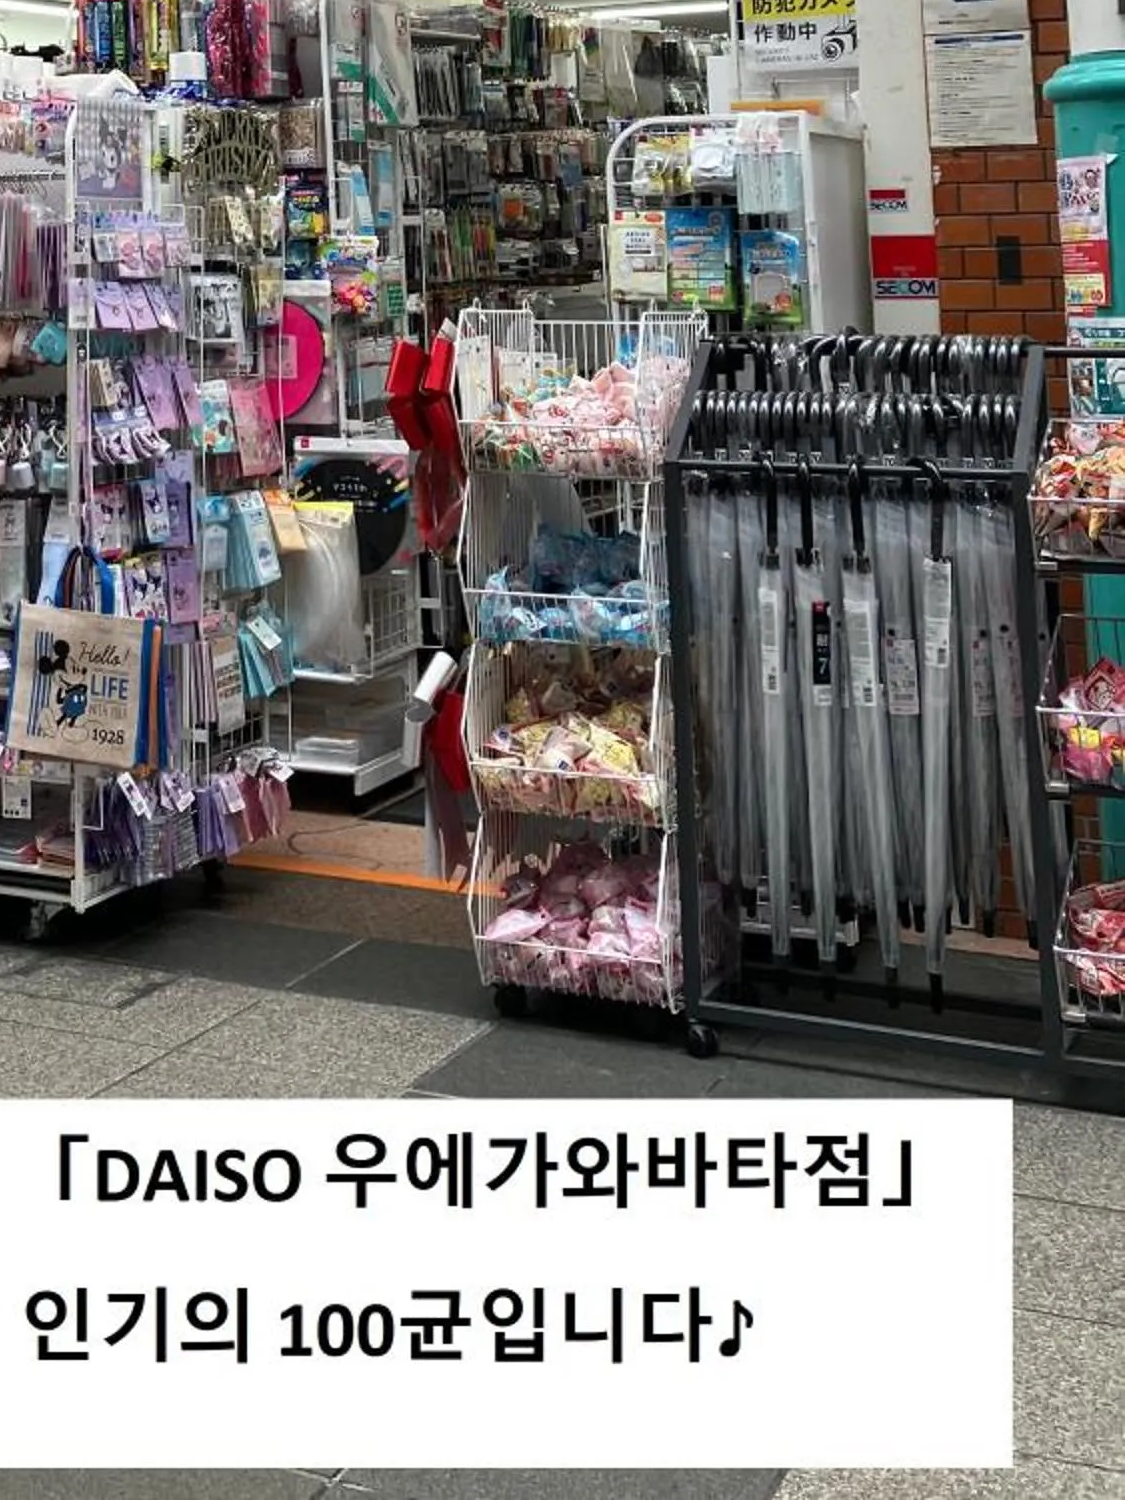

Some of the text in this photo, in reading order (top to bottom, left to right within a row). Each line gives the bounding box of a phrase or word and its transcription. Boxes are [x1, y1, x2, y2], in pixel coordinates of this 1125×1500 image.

[755, 21, 817, 43] 作動中
[876, 280, 936, 295] SECOM
[91, 673, 129, 700] LIFE
